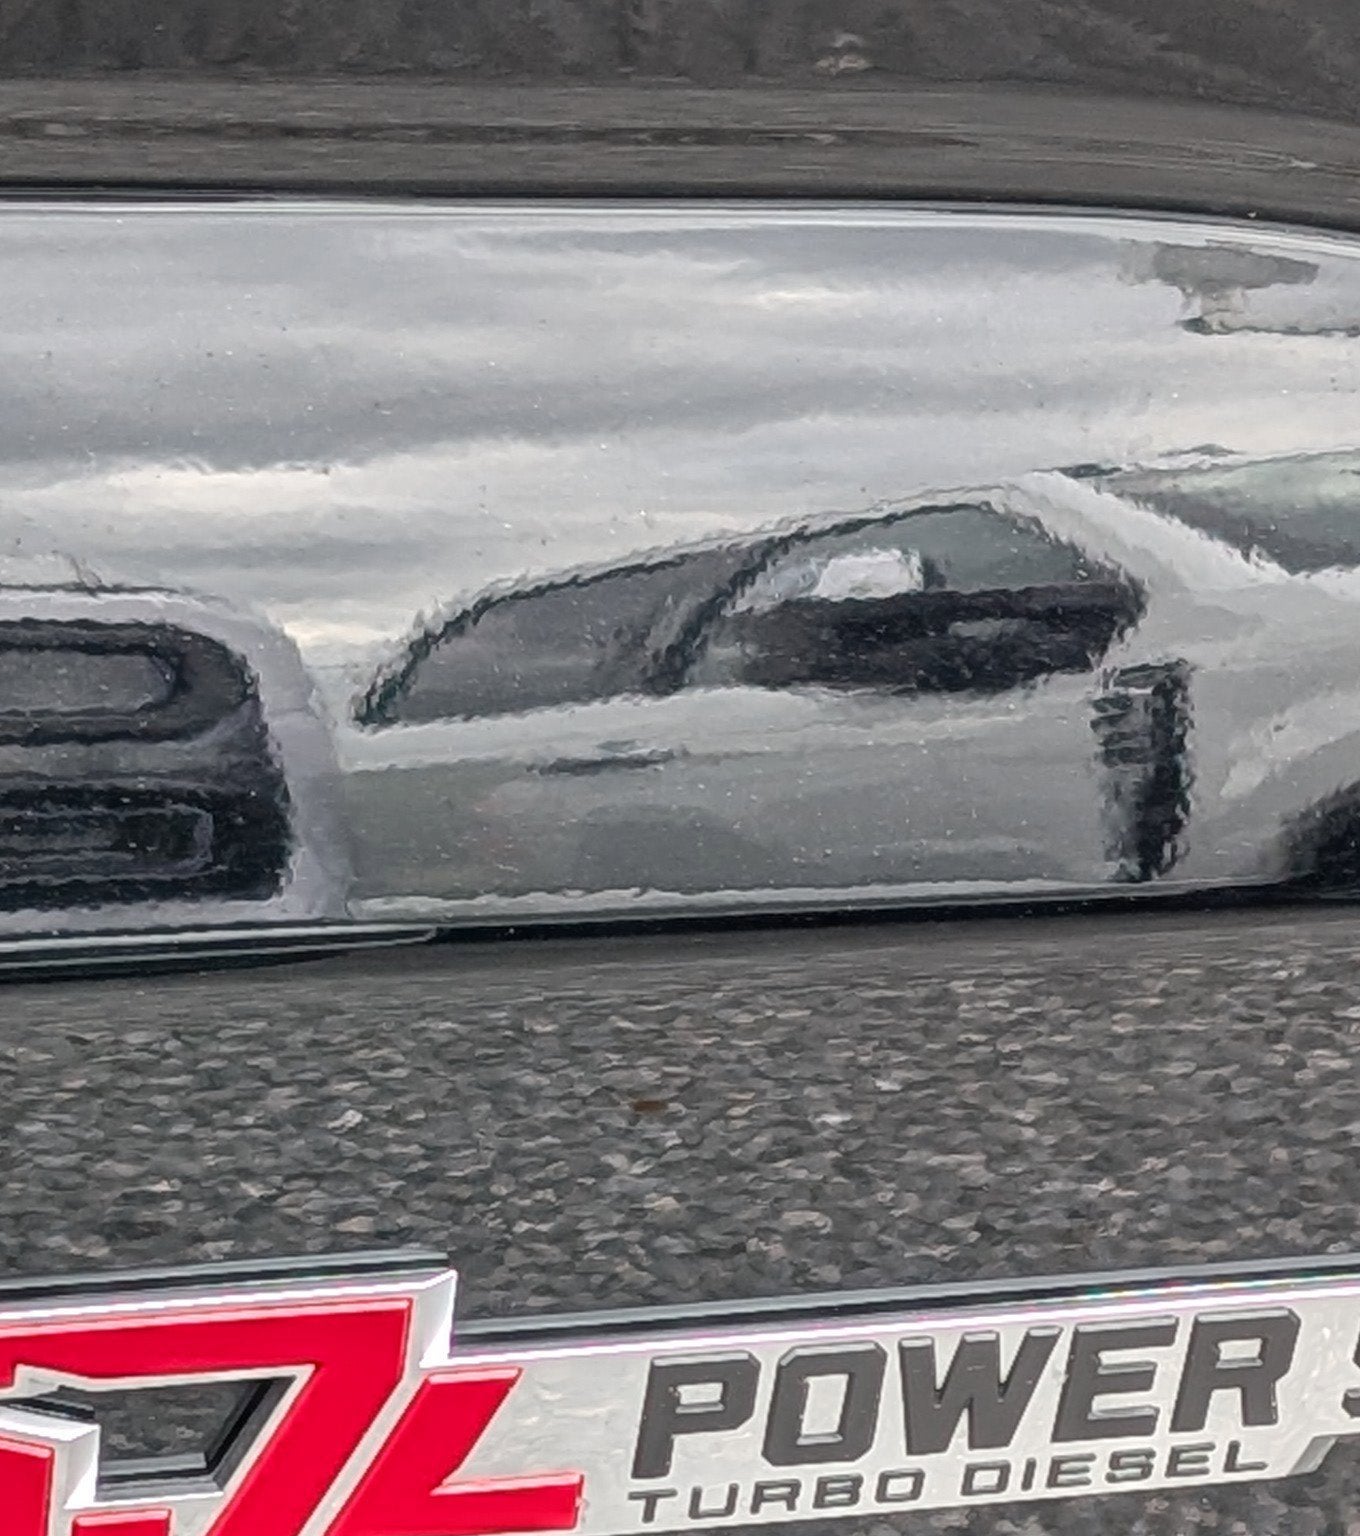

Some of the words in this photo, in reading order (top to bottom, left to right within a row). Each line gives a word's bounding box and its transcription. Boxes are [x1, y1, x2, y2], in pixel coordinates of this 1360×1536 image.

[629, 1306, 1303, 1480] POWER
[627, 1468, 925, 1524] TURBO
[960, 1440, 1269, 1497] DIESEL
